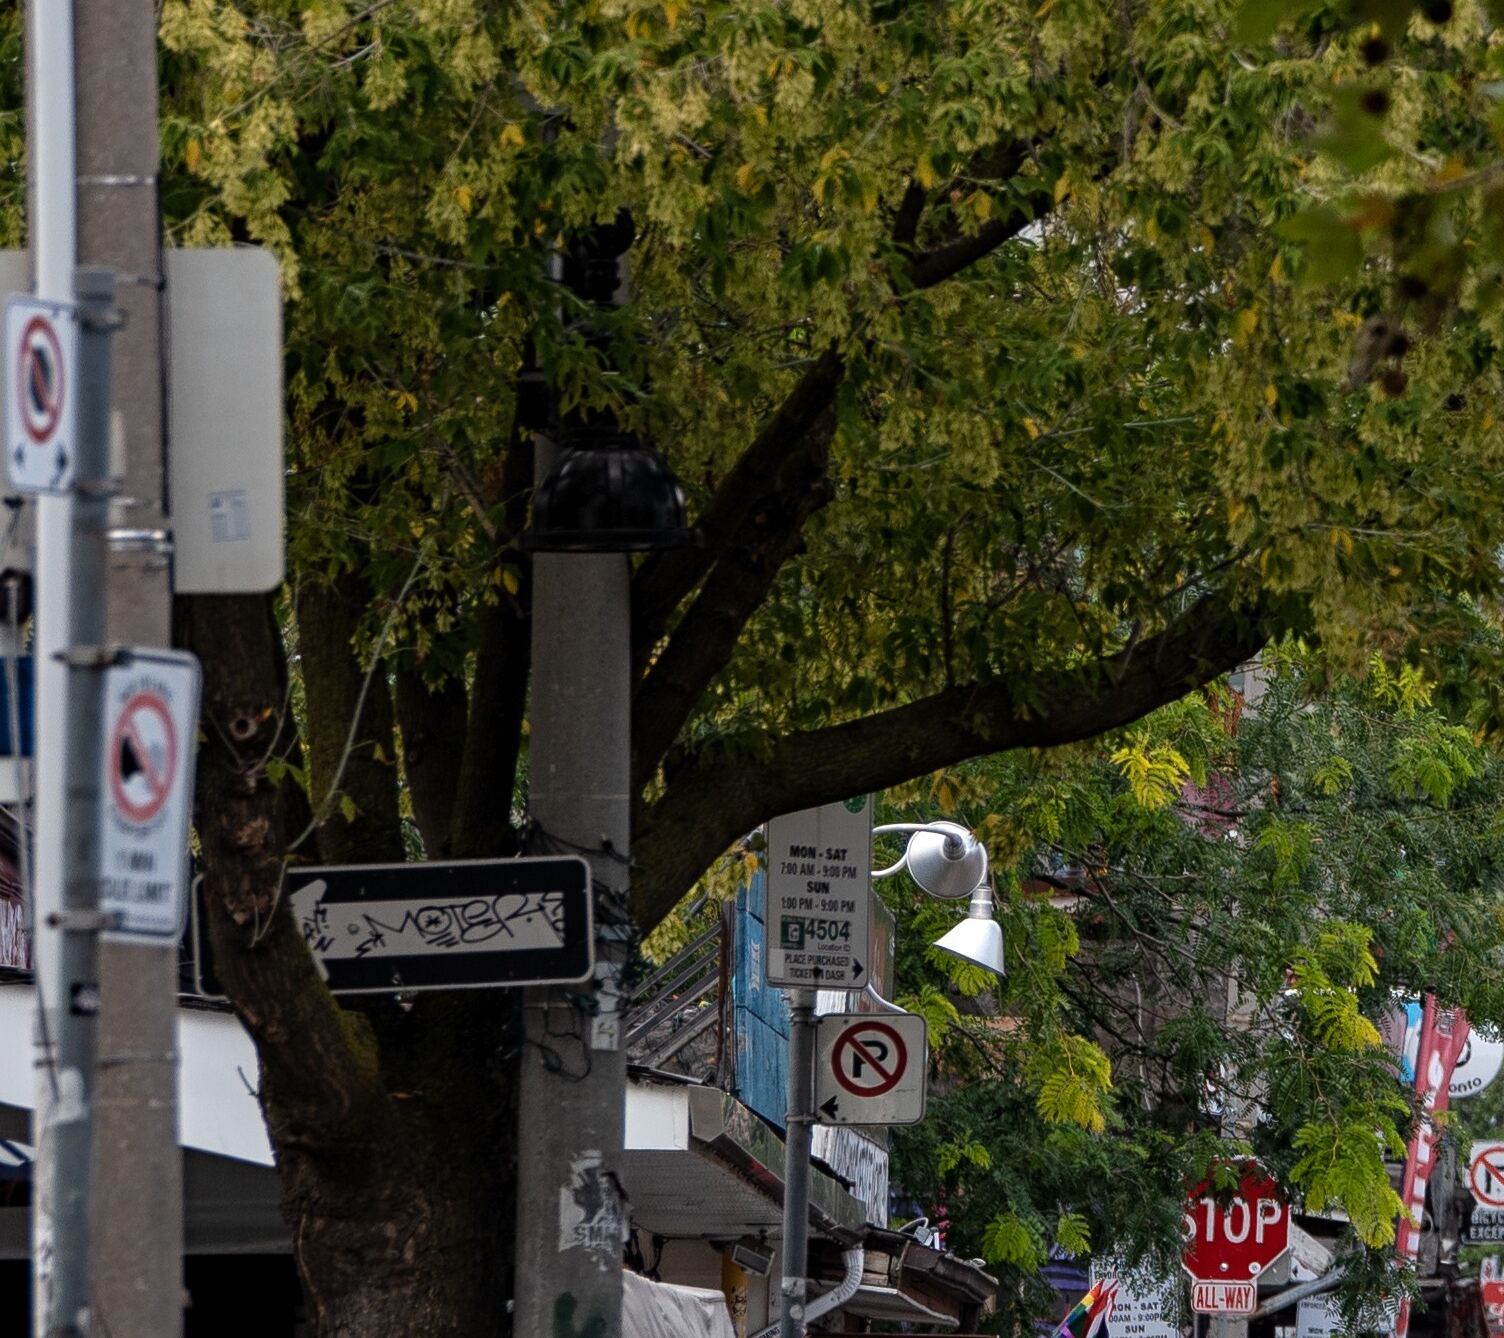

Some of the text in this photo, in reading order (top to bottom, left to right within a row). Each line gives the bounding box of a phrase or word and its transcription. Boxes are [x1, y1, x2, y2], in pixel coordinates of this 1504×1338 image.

[789, 845, 848, 861] MON SAT
[781, 862, 857, 879] 7:00 AM 9:00 PM
[806, 880, 830, 894] SUN
[800, 898, 813, 911] PM
[840, 900, 855, 913] PM
[805, 920, 851, 941] 4504
[784, 954, 849, 967] PLACE PURCHASED
[825, 969, 845, 981] DASH
[1197, 1286, 1251, 1309] ALL-WAY
[1141, 1302, 1158, 1310] SAT
[1125, 1325, 1145, 1334] SUN
